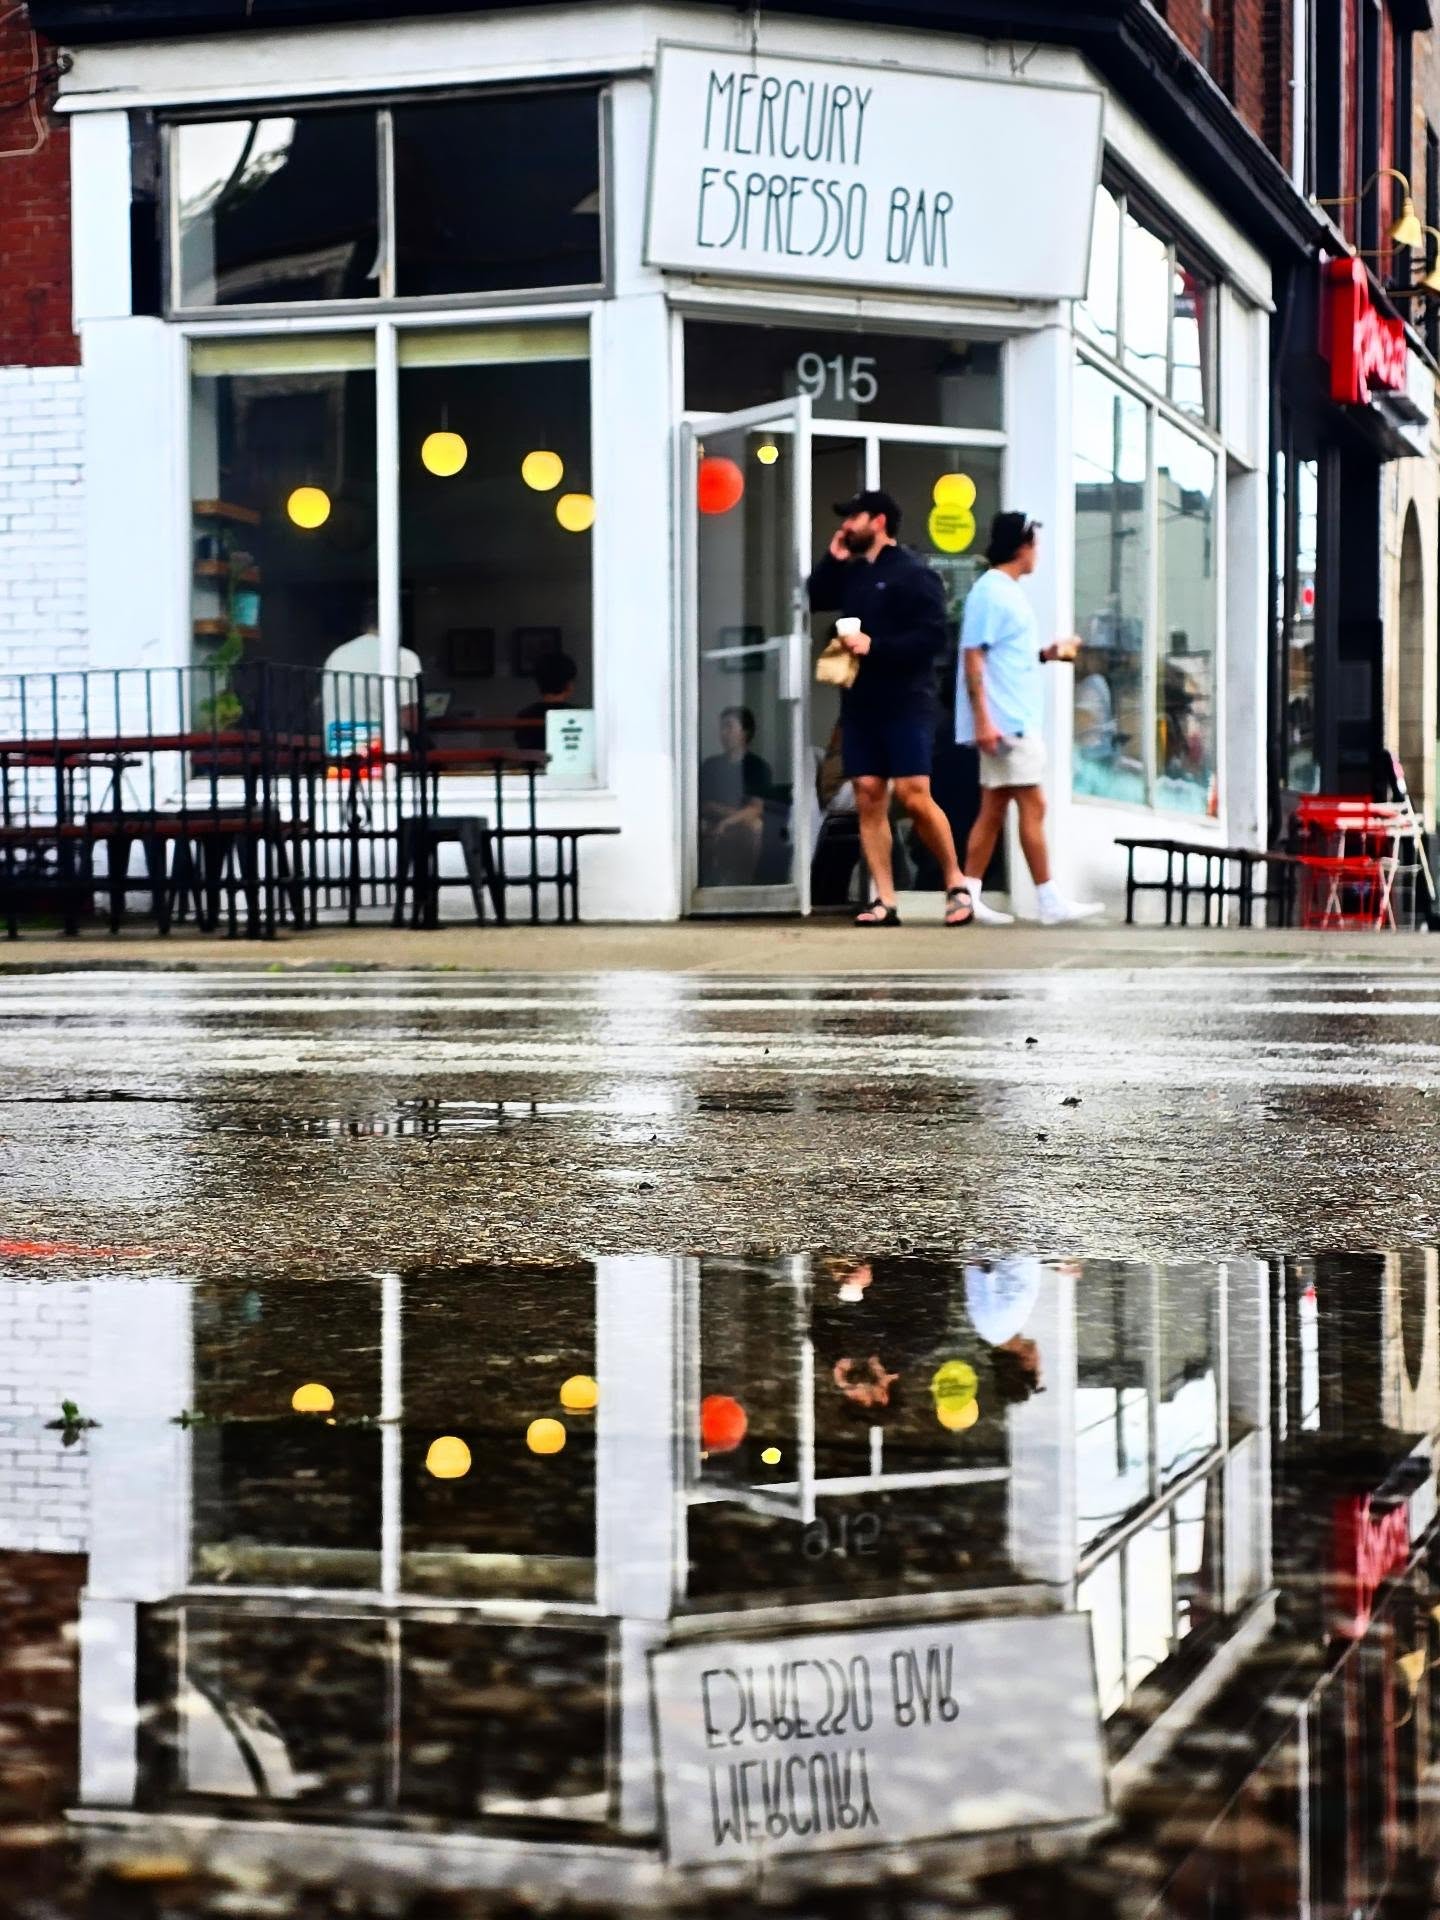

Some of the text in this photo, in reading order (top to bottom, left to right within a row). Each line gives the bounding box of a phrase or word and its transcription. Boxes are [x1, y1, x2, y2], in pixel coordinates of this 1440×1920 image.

[703, 69, 873, 165] MERCURY
[697, 167, 954, 269] ESPRESSO BAR
[796, 352, 878, 403] 915
